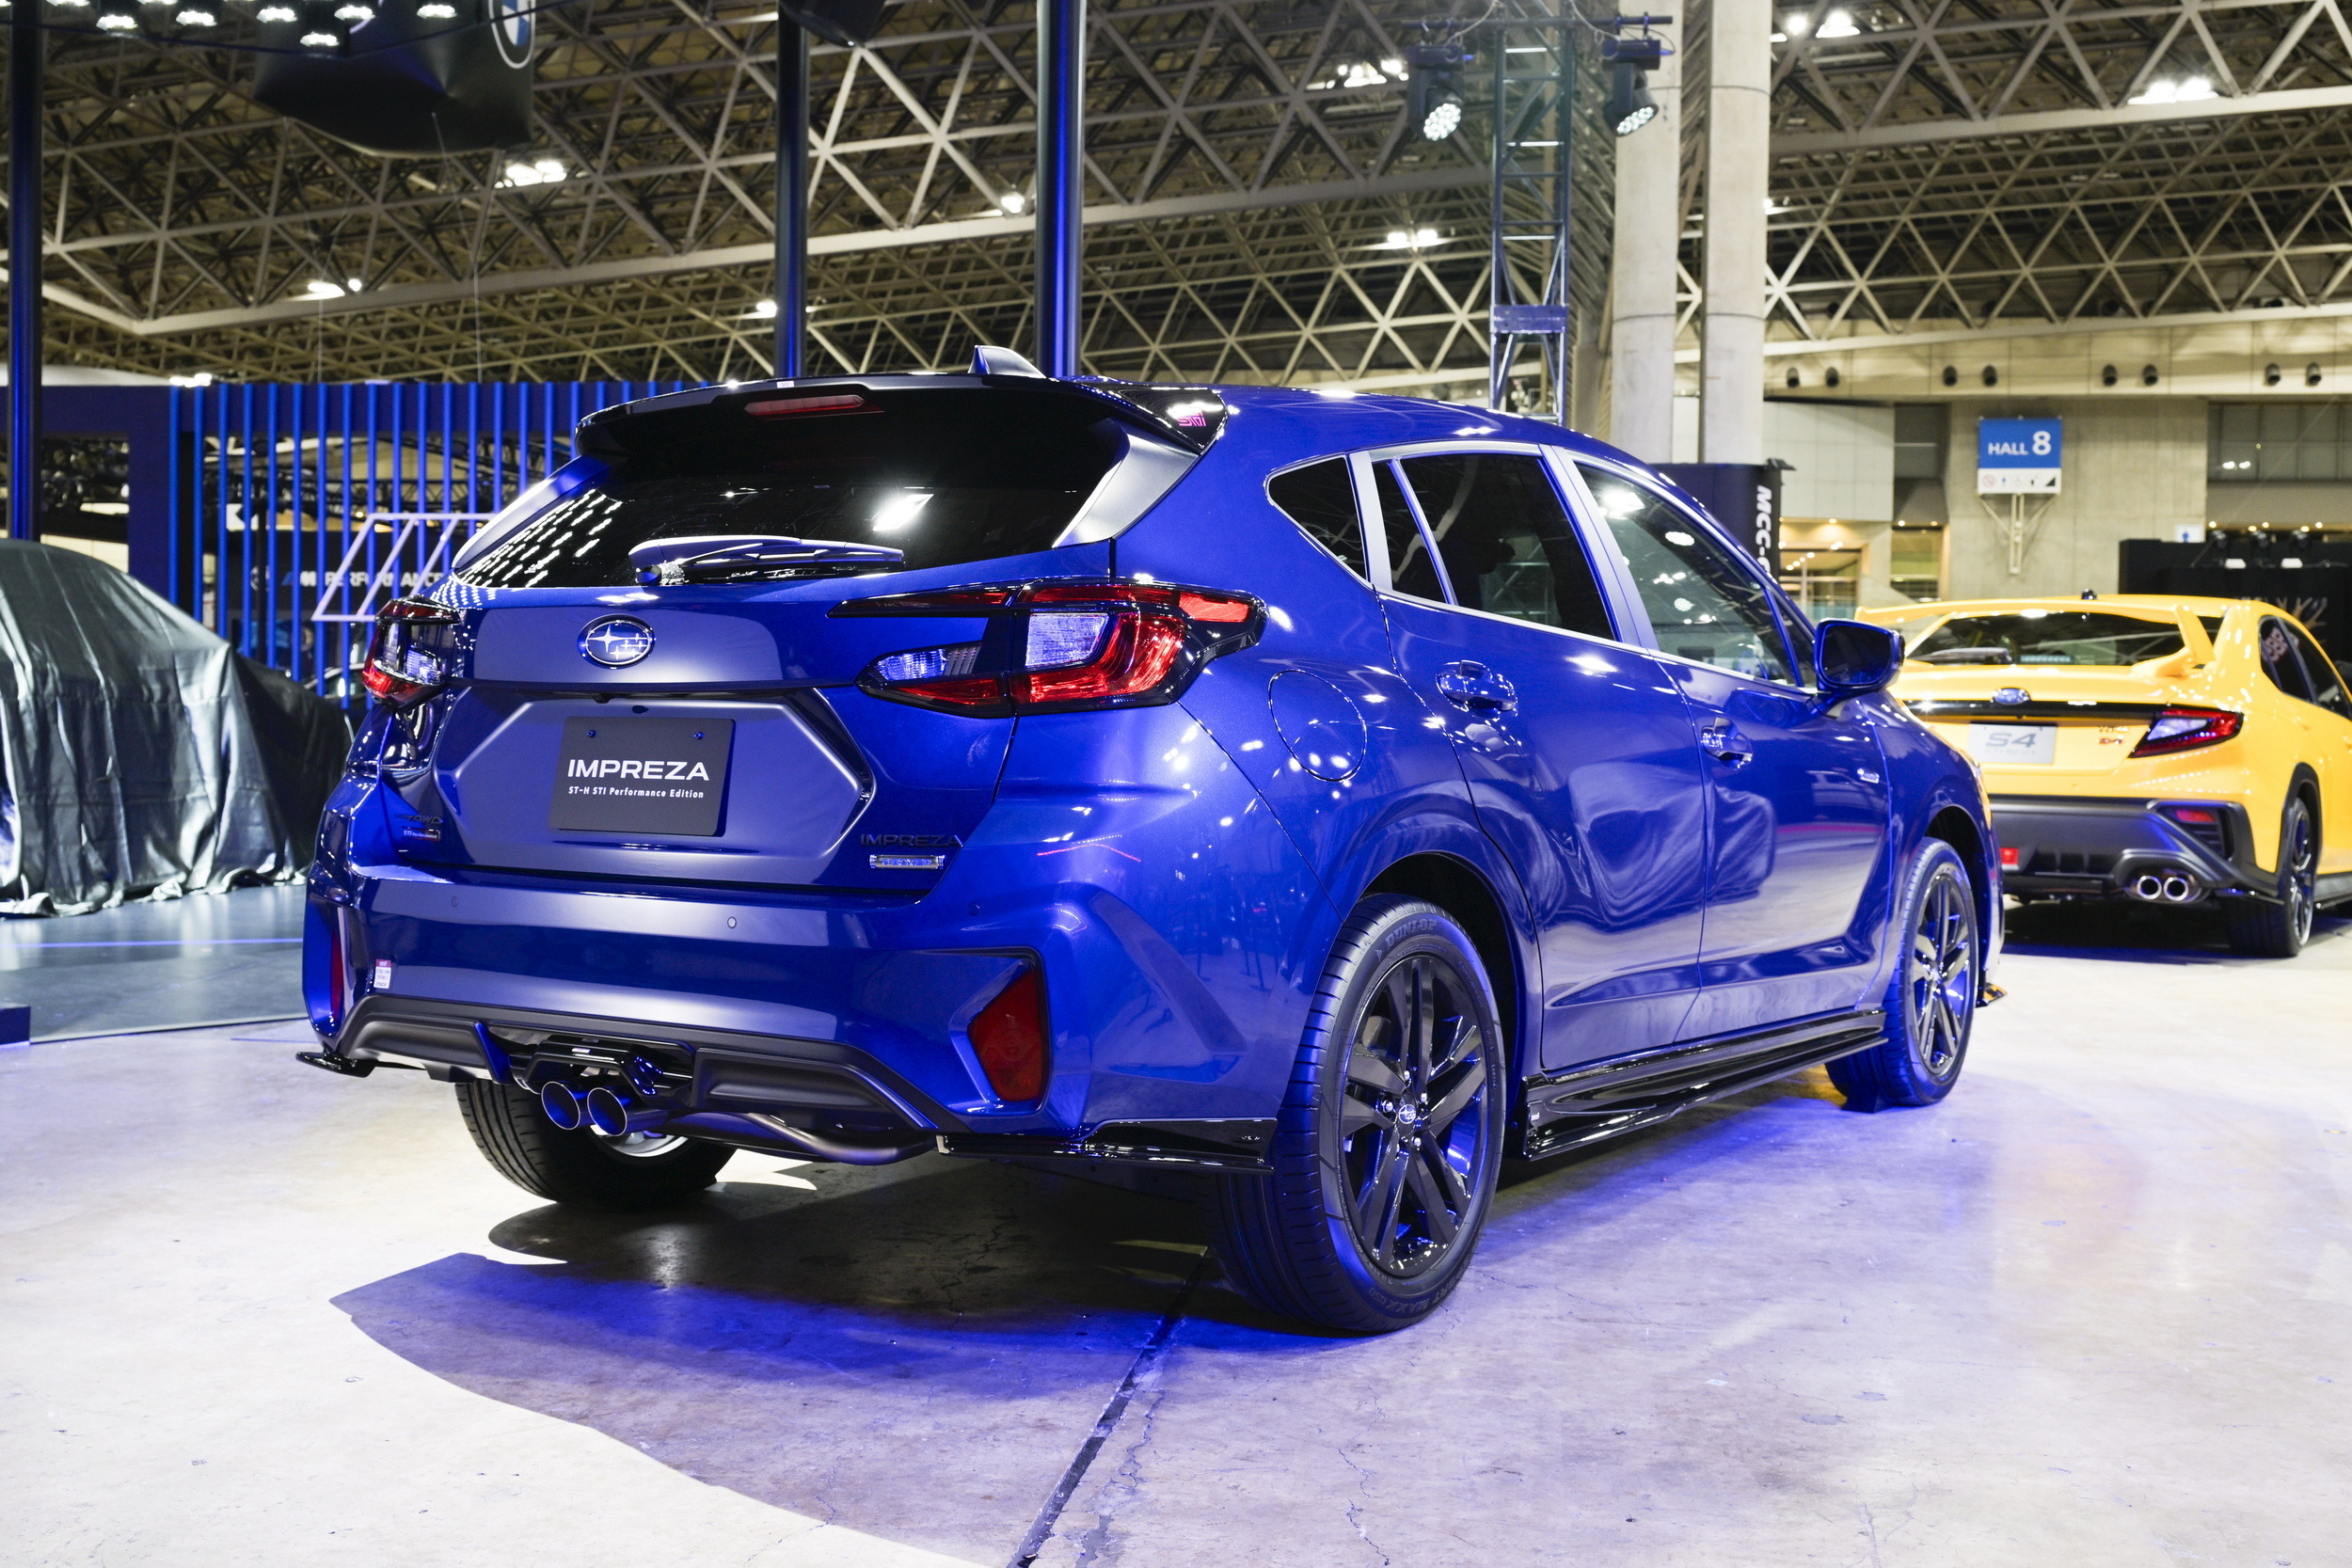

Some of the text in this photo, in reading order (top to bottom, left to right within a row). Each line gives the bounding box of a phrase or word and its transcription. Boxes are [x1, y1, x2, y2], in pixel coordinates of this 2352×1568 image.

[1988, 431, 2051, 455] HALL 8
[1985, 732, 2038, 749] S4
[567, 759, 709, 781] IMPREZA
[568, 785, 704, 799] ST-H STI Performance Edition
[860, 833, 963, 847] IMPREZA
[1385, 918, 1438, 947] DUNLOP
